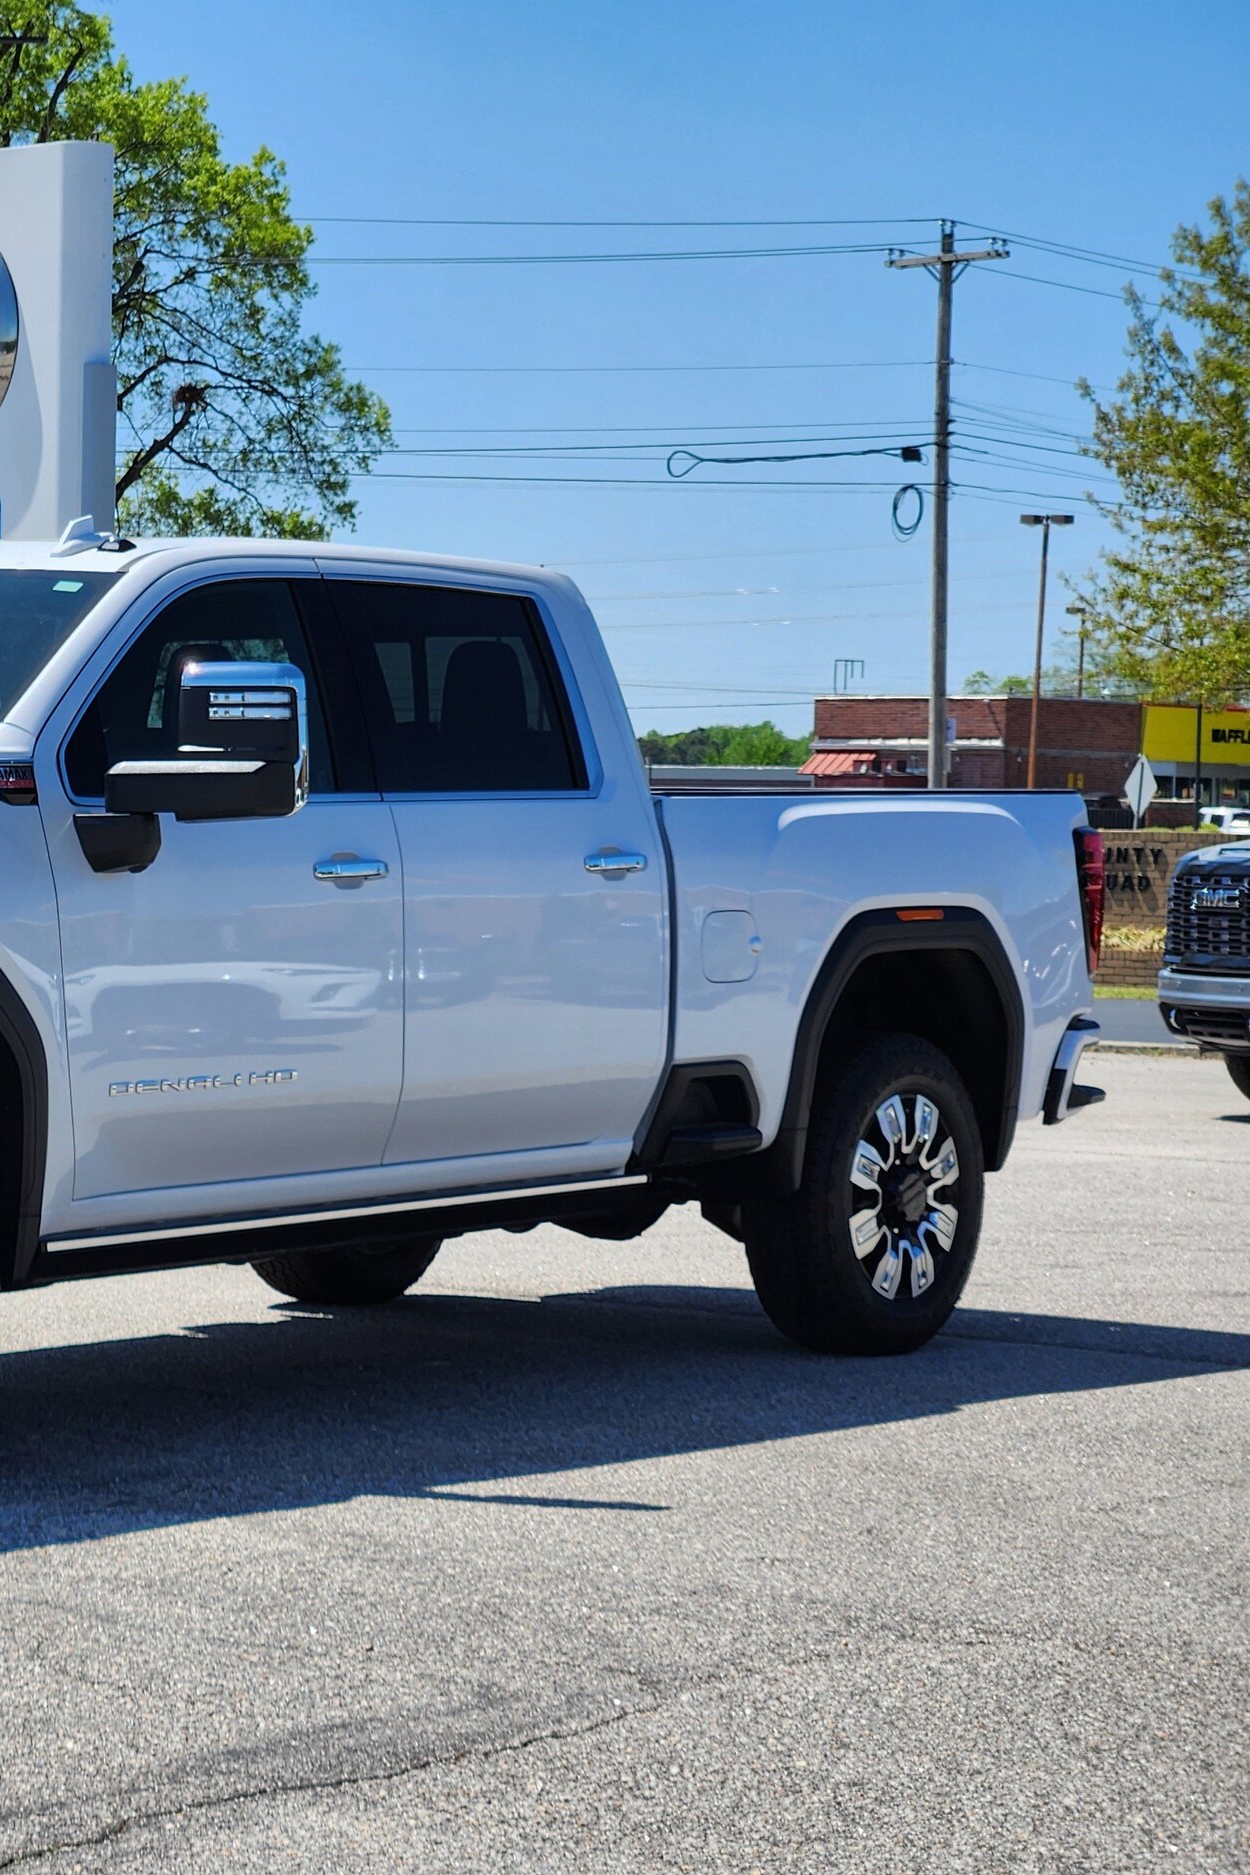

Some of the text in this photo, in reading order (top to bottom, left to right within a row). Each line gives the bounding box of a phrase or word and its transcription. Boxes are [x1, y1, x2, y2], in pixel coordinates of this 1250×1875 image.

[1194, 888, 1240, 908] GMC
[108, 1068, 299, 1097] DENALI HD
